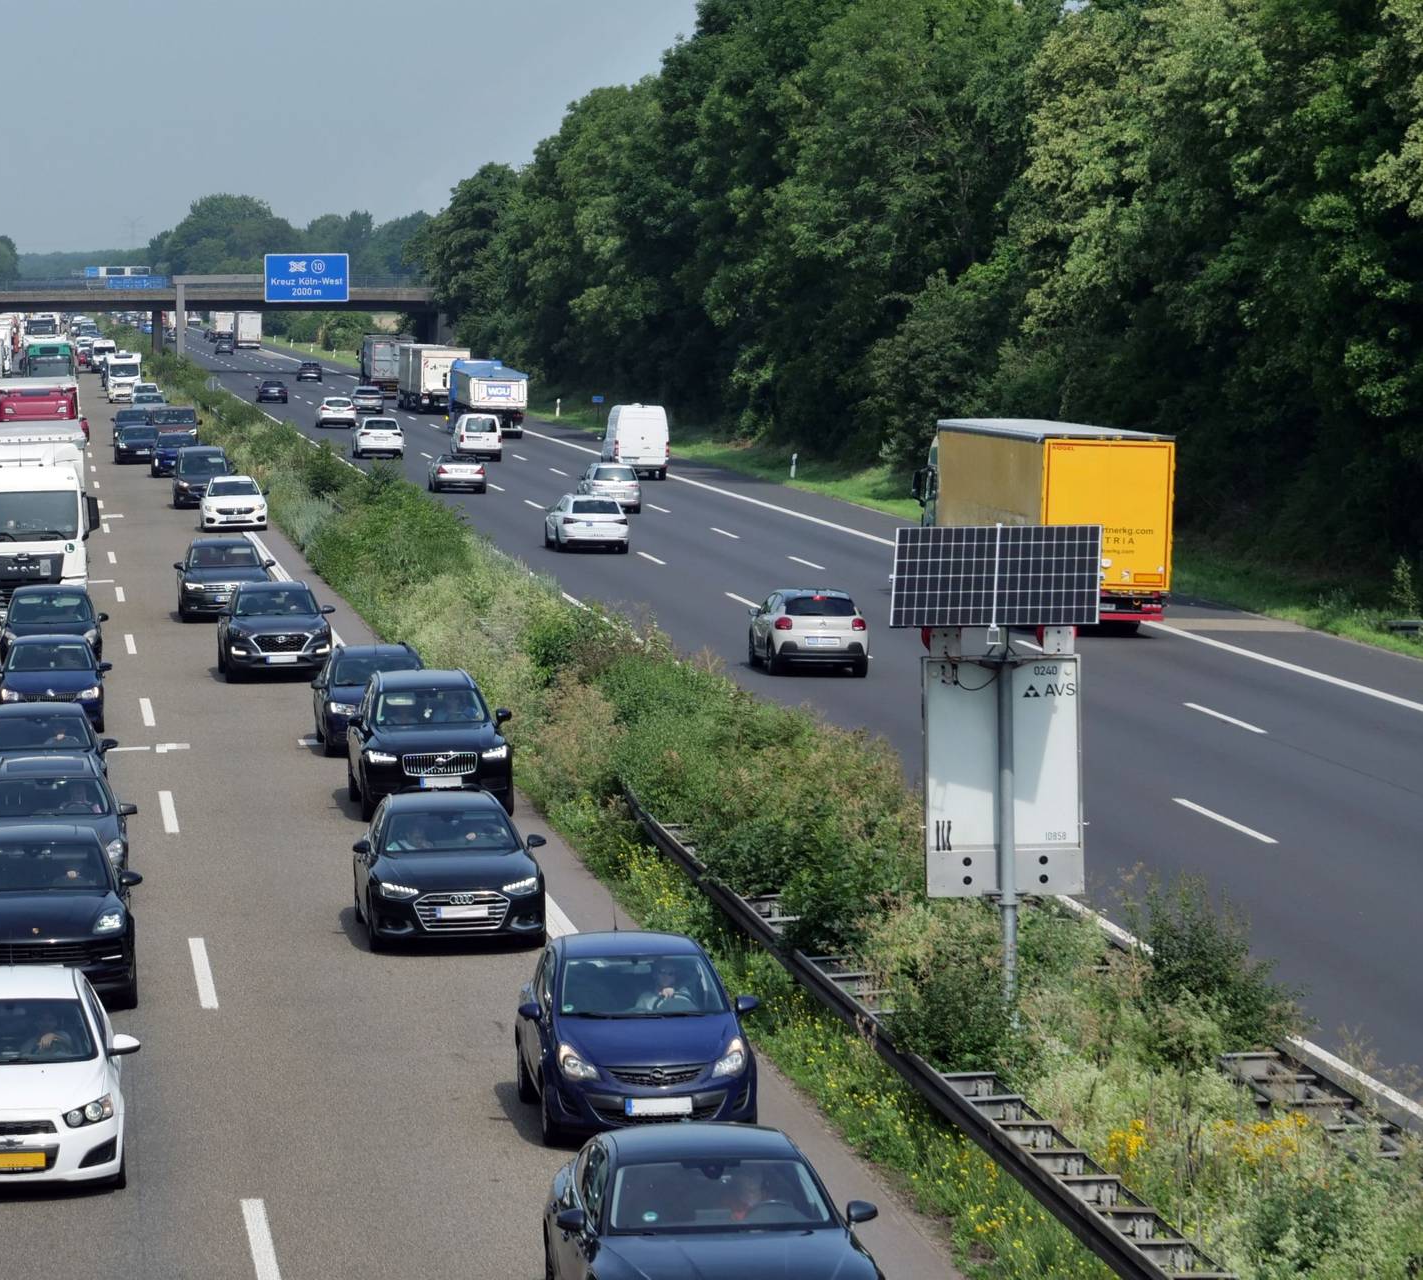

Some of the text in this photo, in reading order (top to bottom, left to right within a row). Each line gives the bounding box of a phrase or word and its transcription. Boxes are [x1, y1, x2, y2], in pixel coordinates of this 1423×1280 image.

[314, 262, 323, 271] 10
[271, 277, 343, 286] Kreuz Köln-West
[292, 287, 312, 296] 2000
[1033, 665, 1058, 676] 0240
[1044, 682, 1076, 697] AVS
